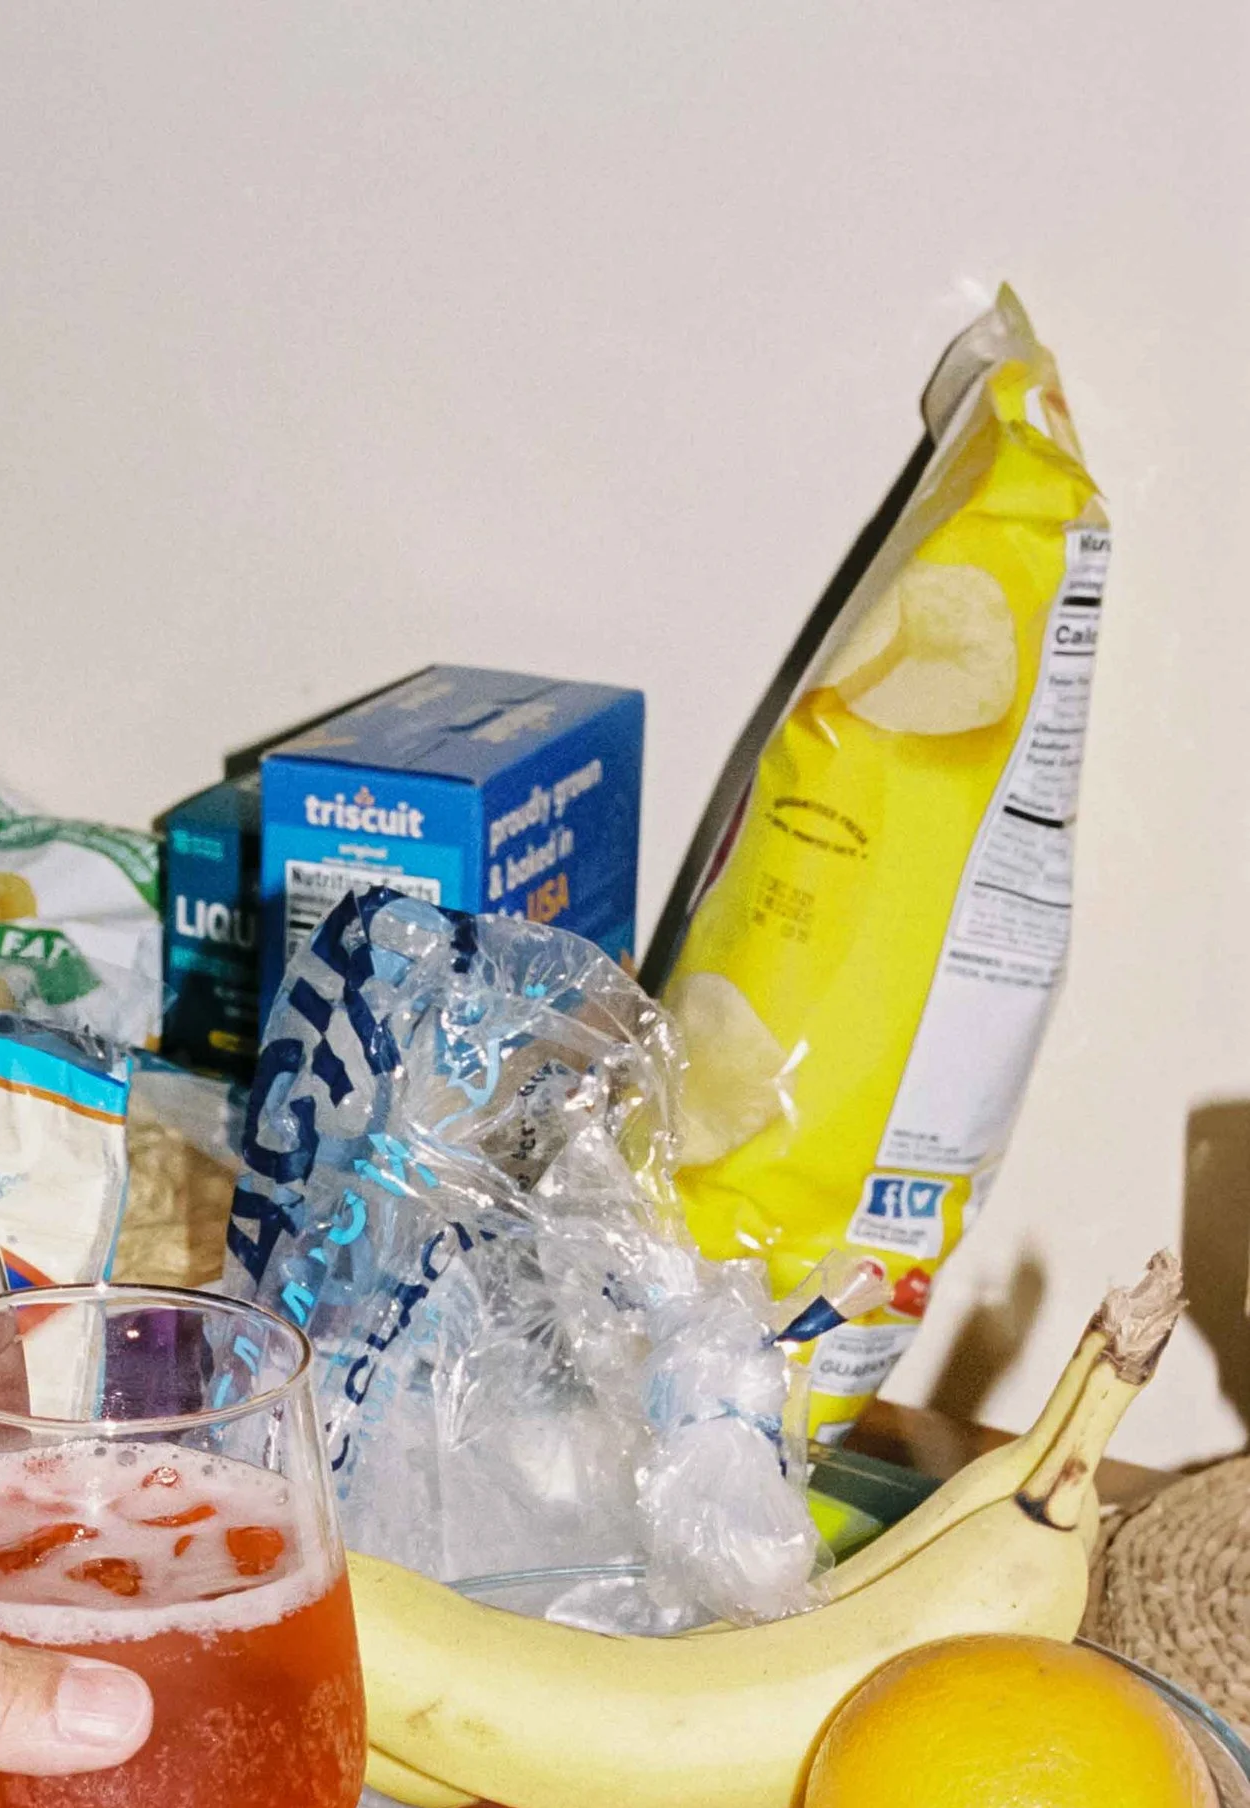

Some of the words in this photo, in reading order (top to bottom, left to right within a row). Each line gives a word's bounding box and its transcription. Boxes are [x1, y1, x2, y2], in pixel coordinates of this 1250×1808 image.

[304, 793, 426, 839] triscuit
[488, 864, 503, 901] &
[526, 872, 570, 923] USA
[175, 894, 256, 947] LIQU
